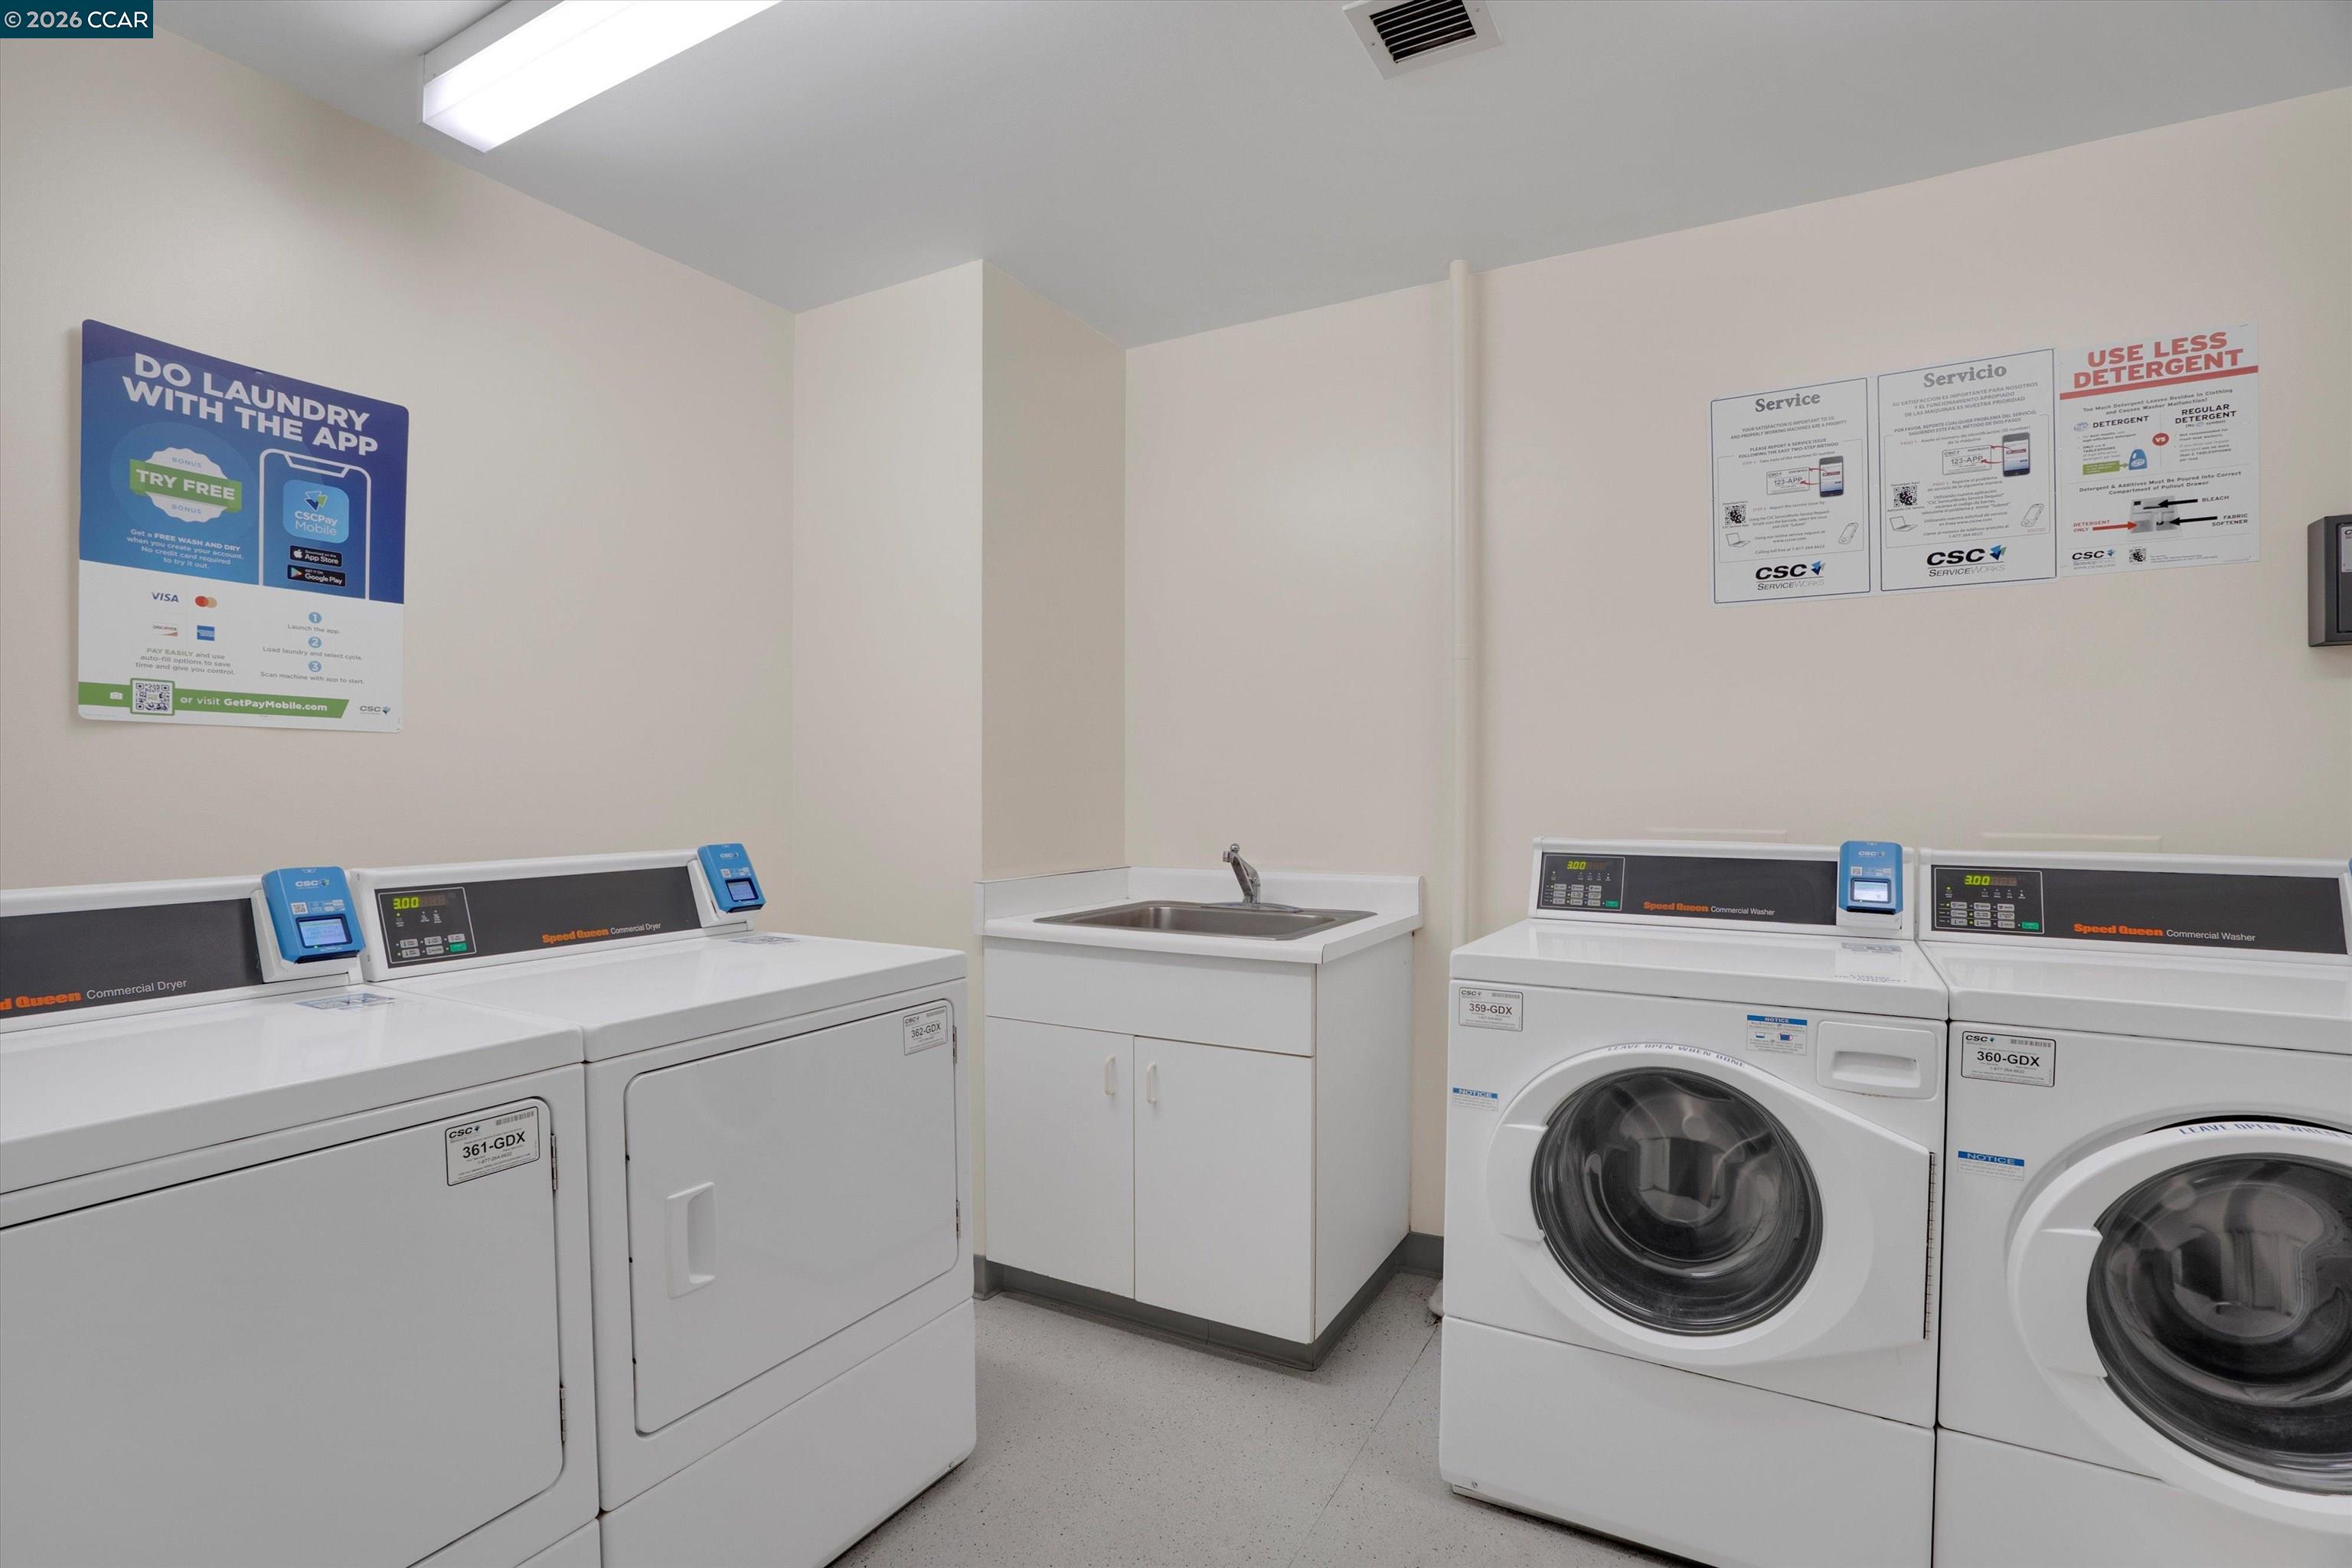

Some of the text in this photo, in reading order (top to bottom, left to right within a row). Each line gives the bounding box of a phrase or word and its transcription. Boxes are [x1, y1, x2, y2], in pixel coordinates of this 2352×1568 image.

[2088, 332, 2227, 368] USE LESS
[2074, 348, 2243, 388] DETERGENT
[1923, 364, 2007, 387] Servicio
[135, 352, 369, 432] DO LAUNDRY
[1950, 382, 2038, 399] IMPORTANTE NOSOTROS
[1756, 394, 1821, 412] Service
[1992, 397, 2025, 405] PRIORIDAD
[2114, 400, 2144, 409] Detergent
[122, 375, 378, 456] WITH THE APP
[2182, 404, 2230, 415] REGULAR
[2093, 416, 2149, 428] DETERGENT
[2175, 410, 2236, 424] DETERGENT
[172, 456, 202, 468] BONUS
[136, 469, 235, 500] TRY FREE
[172, 504, 201, 514] BONUS
[295, 511, 337, 526] CSCPay
[295, 521, 337, 535] Mobile
[155, 533, 175, 541] FREE
[178, 537, 203, 546] WASH
[199, 556, 230, 564] required
[213, 550, 244, 559] account.
[1926, 548, 1984, 566] CSC
[2072, 550, 2104, 560] CSC
[305, 573, 328, 582] Google
[1756, 564, 1807, 580] CSC
[152, 592, 179, 603] VISA
[181, 696, 328, 711] or visit GetPayMobile.com
[1567, 861, 1586, 870] 3.00
[1965, 876, 1990, 885] 3.00
[394, 897, 419, 910] 3.00
[1643, 901, 1775, 916] Speed Queen Commercial Washer
[542, 923, 661, 944] Speed Queen Commercial Dryer
[2073, 923, 2256, 942] Speed Queen Commercial Washer
[15, 991, 81, 1008] Queen
[86, 983, 155, 1000] Commercial
[158, 979, 187, 991] Dryer
[1470, 1003, 1512, 1015] 359-GDX
[911, 1023, 941, 1038] 362-GDX
[1678, 1047, 1711, 1056] WHEN
[1977, 1051, 2040, 1067] 360-GDX
[1459, 1089, 1491, 1097] NOTICE
[449, 1127, 472, 1138] CSC
[2180, 1124, 2230, 1135] LEAVE
[2285, 1125, 2339, 1138] WHEN
[463, 1131, 525, 1158] 361-GDX
[1968, 1153, 2015, 1165] NOTICE
